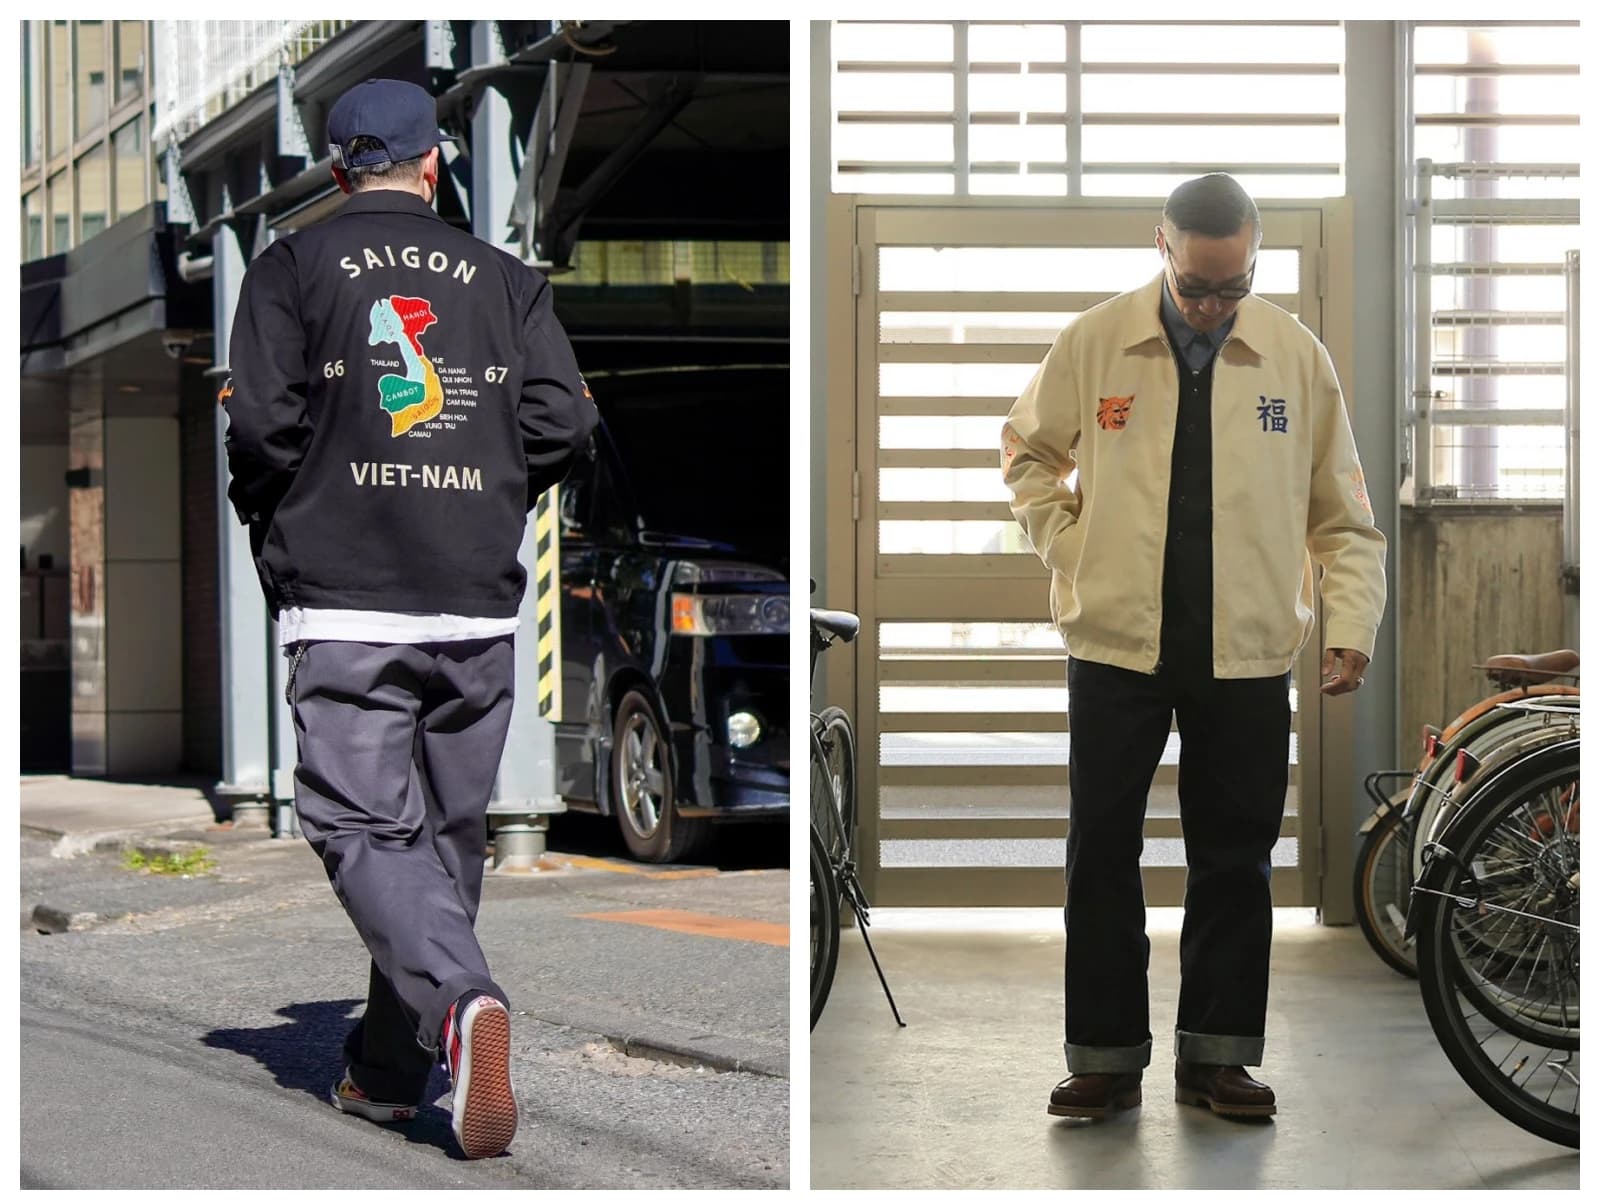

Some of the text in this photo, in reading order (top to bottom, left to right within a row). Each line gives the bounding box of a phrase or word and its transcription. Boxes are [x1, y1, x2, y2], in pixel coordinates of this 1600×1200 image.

[340, 245, 477, 284] SAIGON
[403, 310, 428, 321] HANOI
[370, 358, 400, 368] THAILAND
[431, 356, 444, 364] HUE
[323, 360, 345, 379] 66
[447, 367, 467, 375] NANG
[484, 366, 508, 384] 67
[445, 388, 479, 397] NHA TRANG
[460, 399, 477, 408] RANH
[454, 414, 468, 422] HOA
[1256, 395, 1289, 434] 福
[424, 422, 456, 430] VUNG TAU
[408, 431, 432, 439] CAMAU
[350, 462, 483, 491] VIET-NAM
